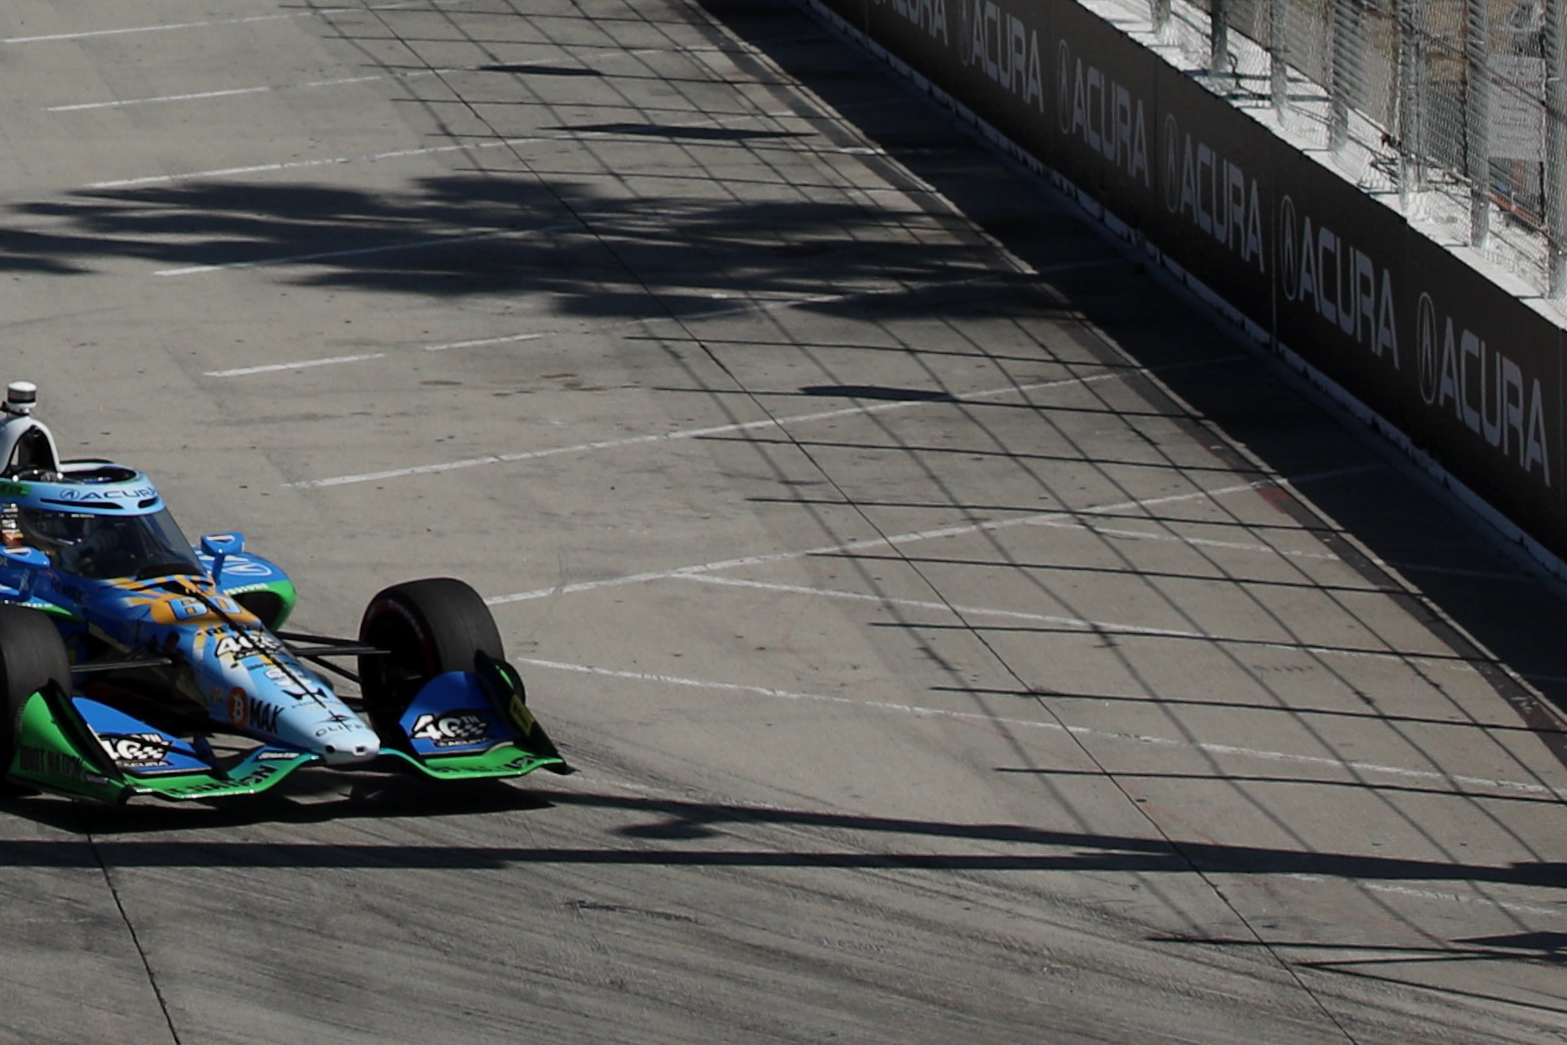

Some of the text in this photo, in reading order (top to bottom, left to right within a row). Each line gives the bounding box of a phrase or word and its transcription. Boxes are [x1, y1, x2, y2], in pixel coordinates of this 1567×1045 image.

[1071, 57, 1150, 188] ACURA
[1180, 132, 1265, 274] ACURA
[1299, 215, 1400, 371] ACURA
[1438, 316, 1551, 488] ACURA
[248, 697, 284, 734] MAX
